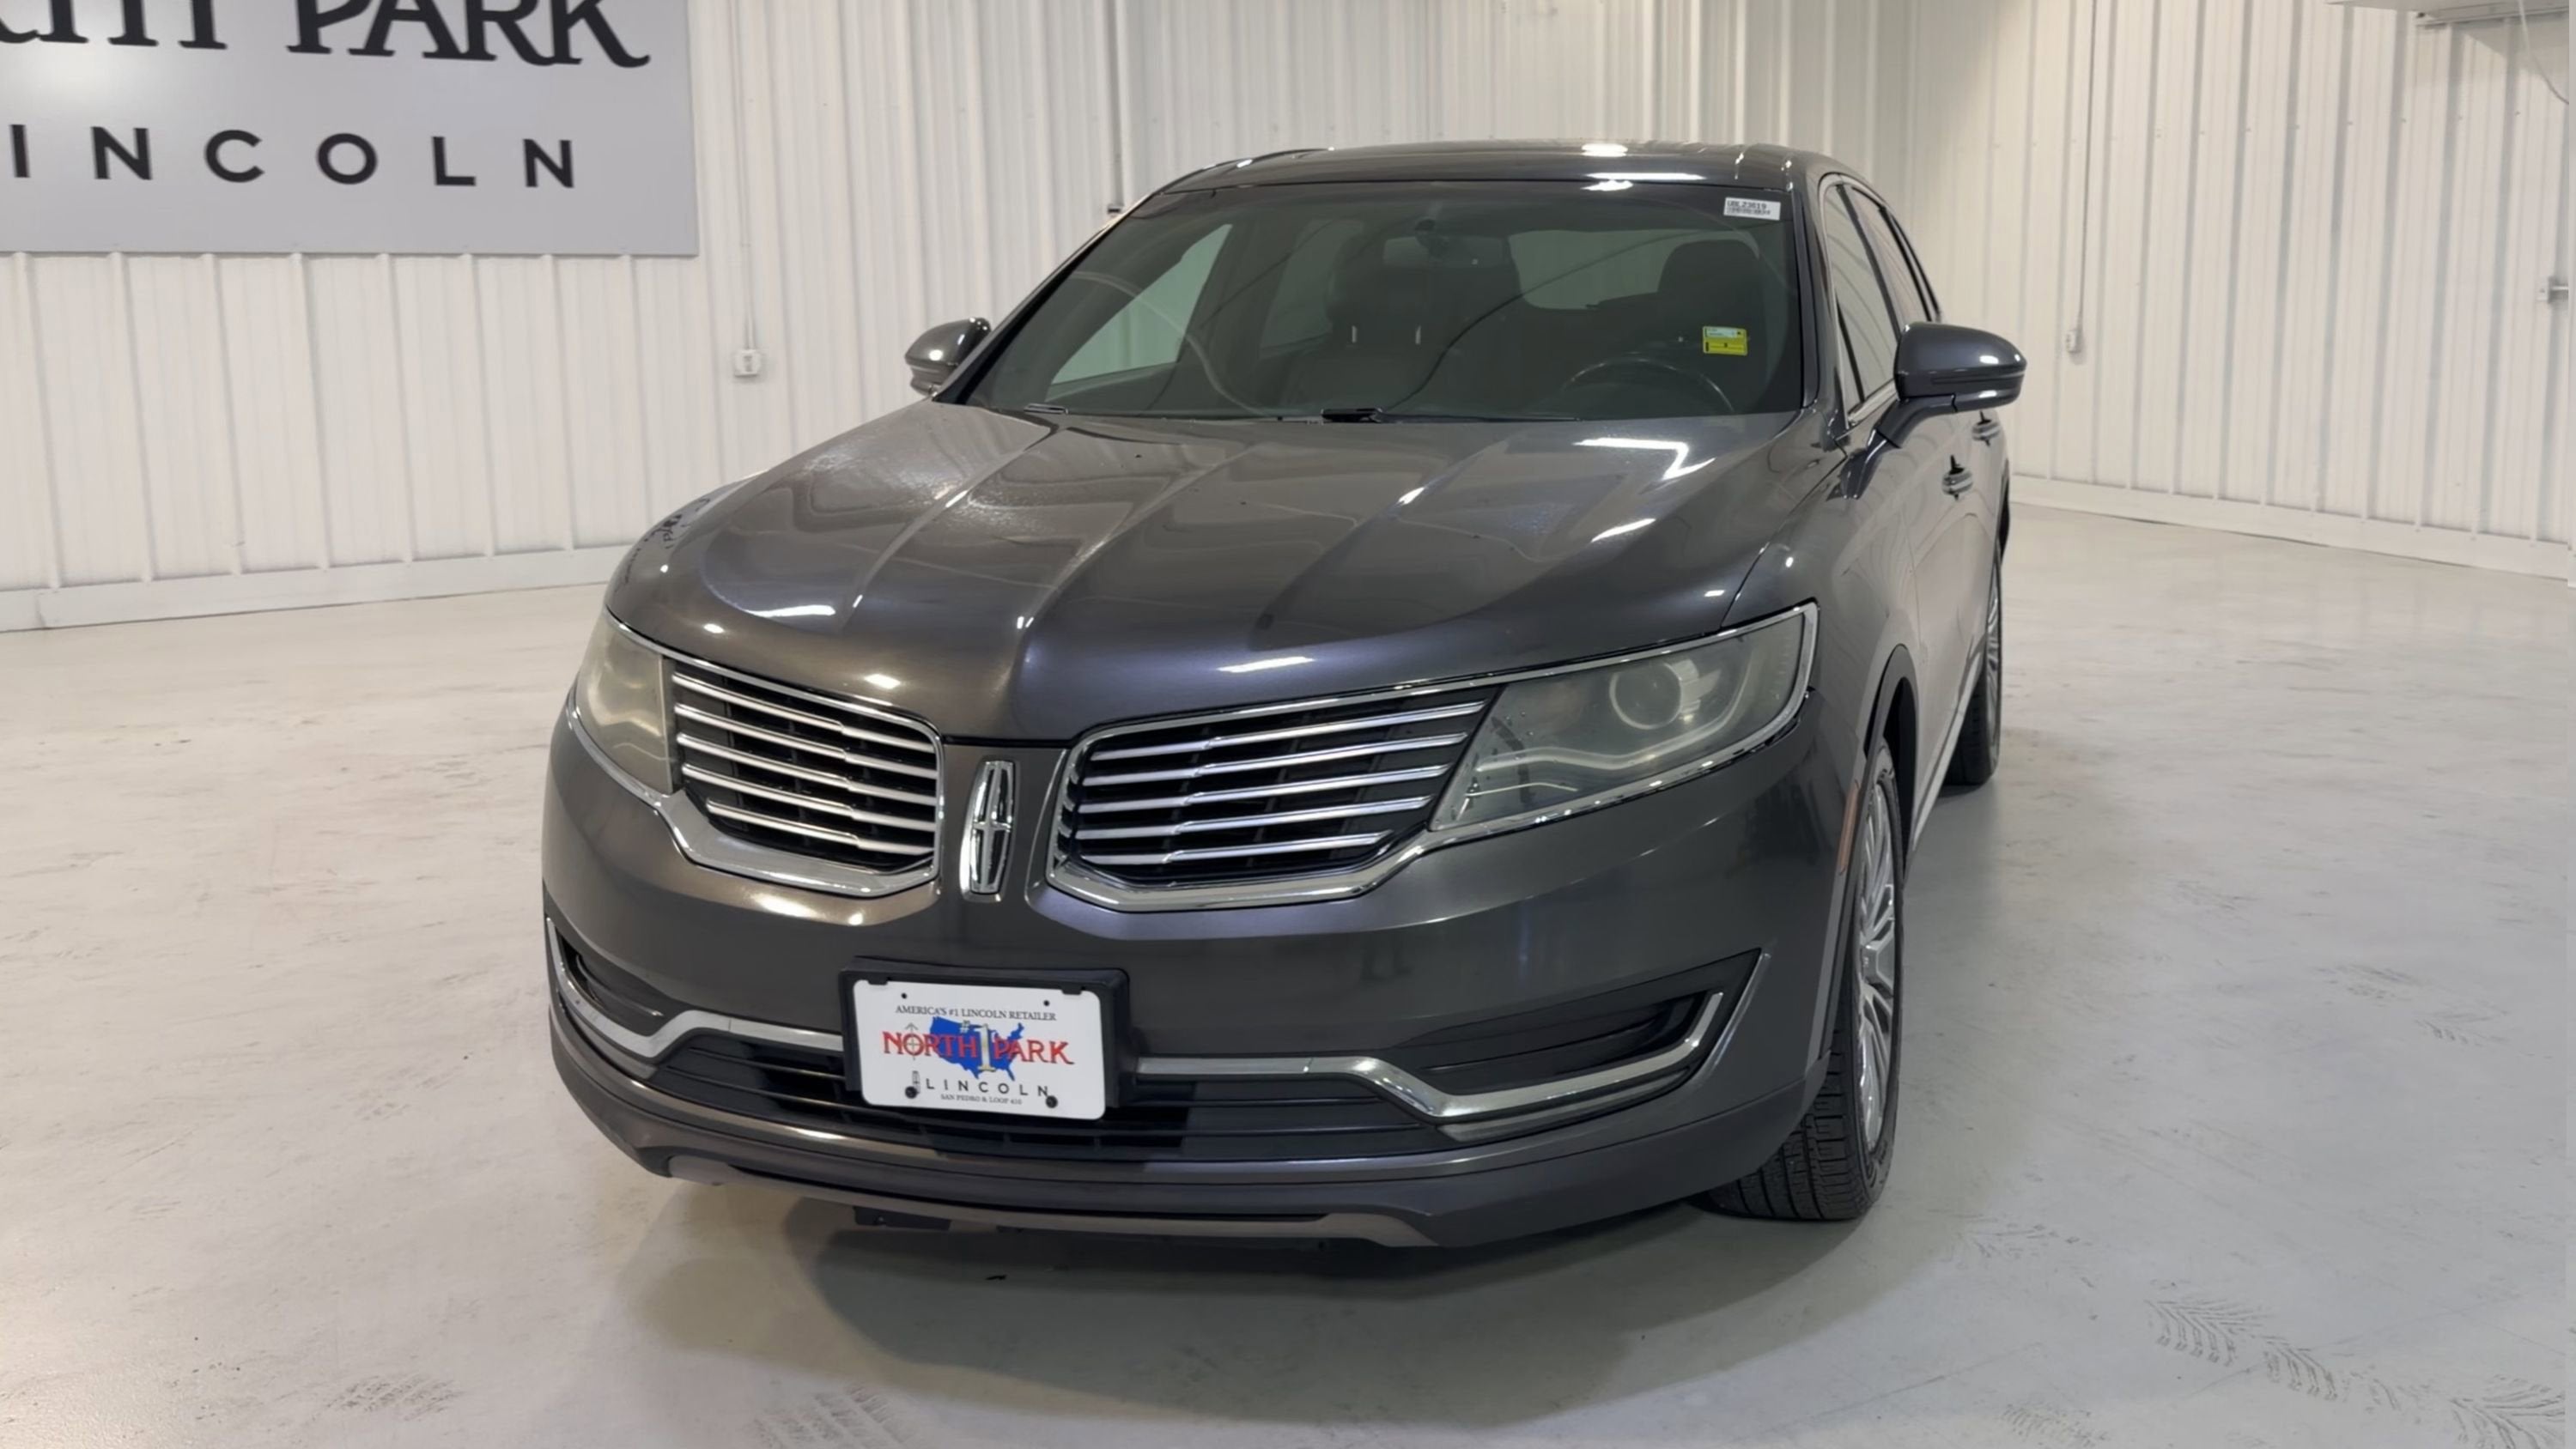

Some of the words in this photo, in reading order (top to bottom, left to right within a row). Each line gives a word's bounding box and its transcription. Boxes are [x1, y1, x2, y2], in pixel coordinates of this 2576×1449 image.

[10, 124, 575, 188] INCOLN
[896, 1005, 946, 1016] AMERICA'S
[949, 1009, 959, 1017] #1
[961, 1009, 1007, 1019] LINCOLN
[1009, 1011, 1057, 1022] RETAILER
[882, 1031, 978, 1058] NORTH
[993, 1034, 1075, 1064] PARK
[926, 1077, 1048, 1097] LINCOLN
